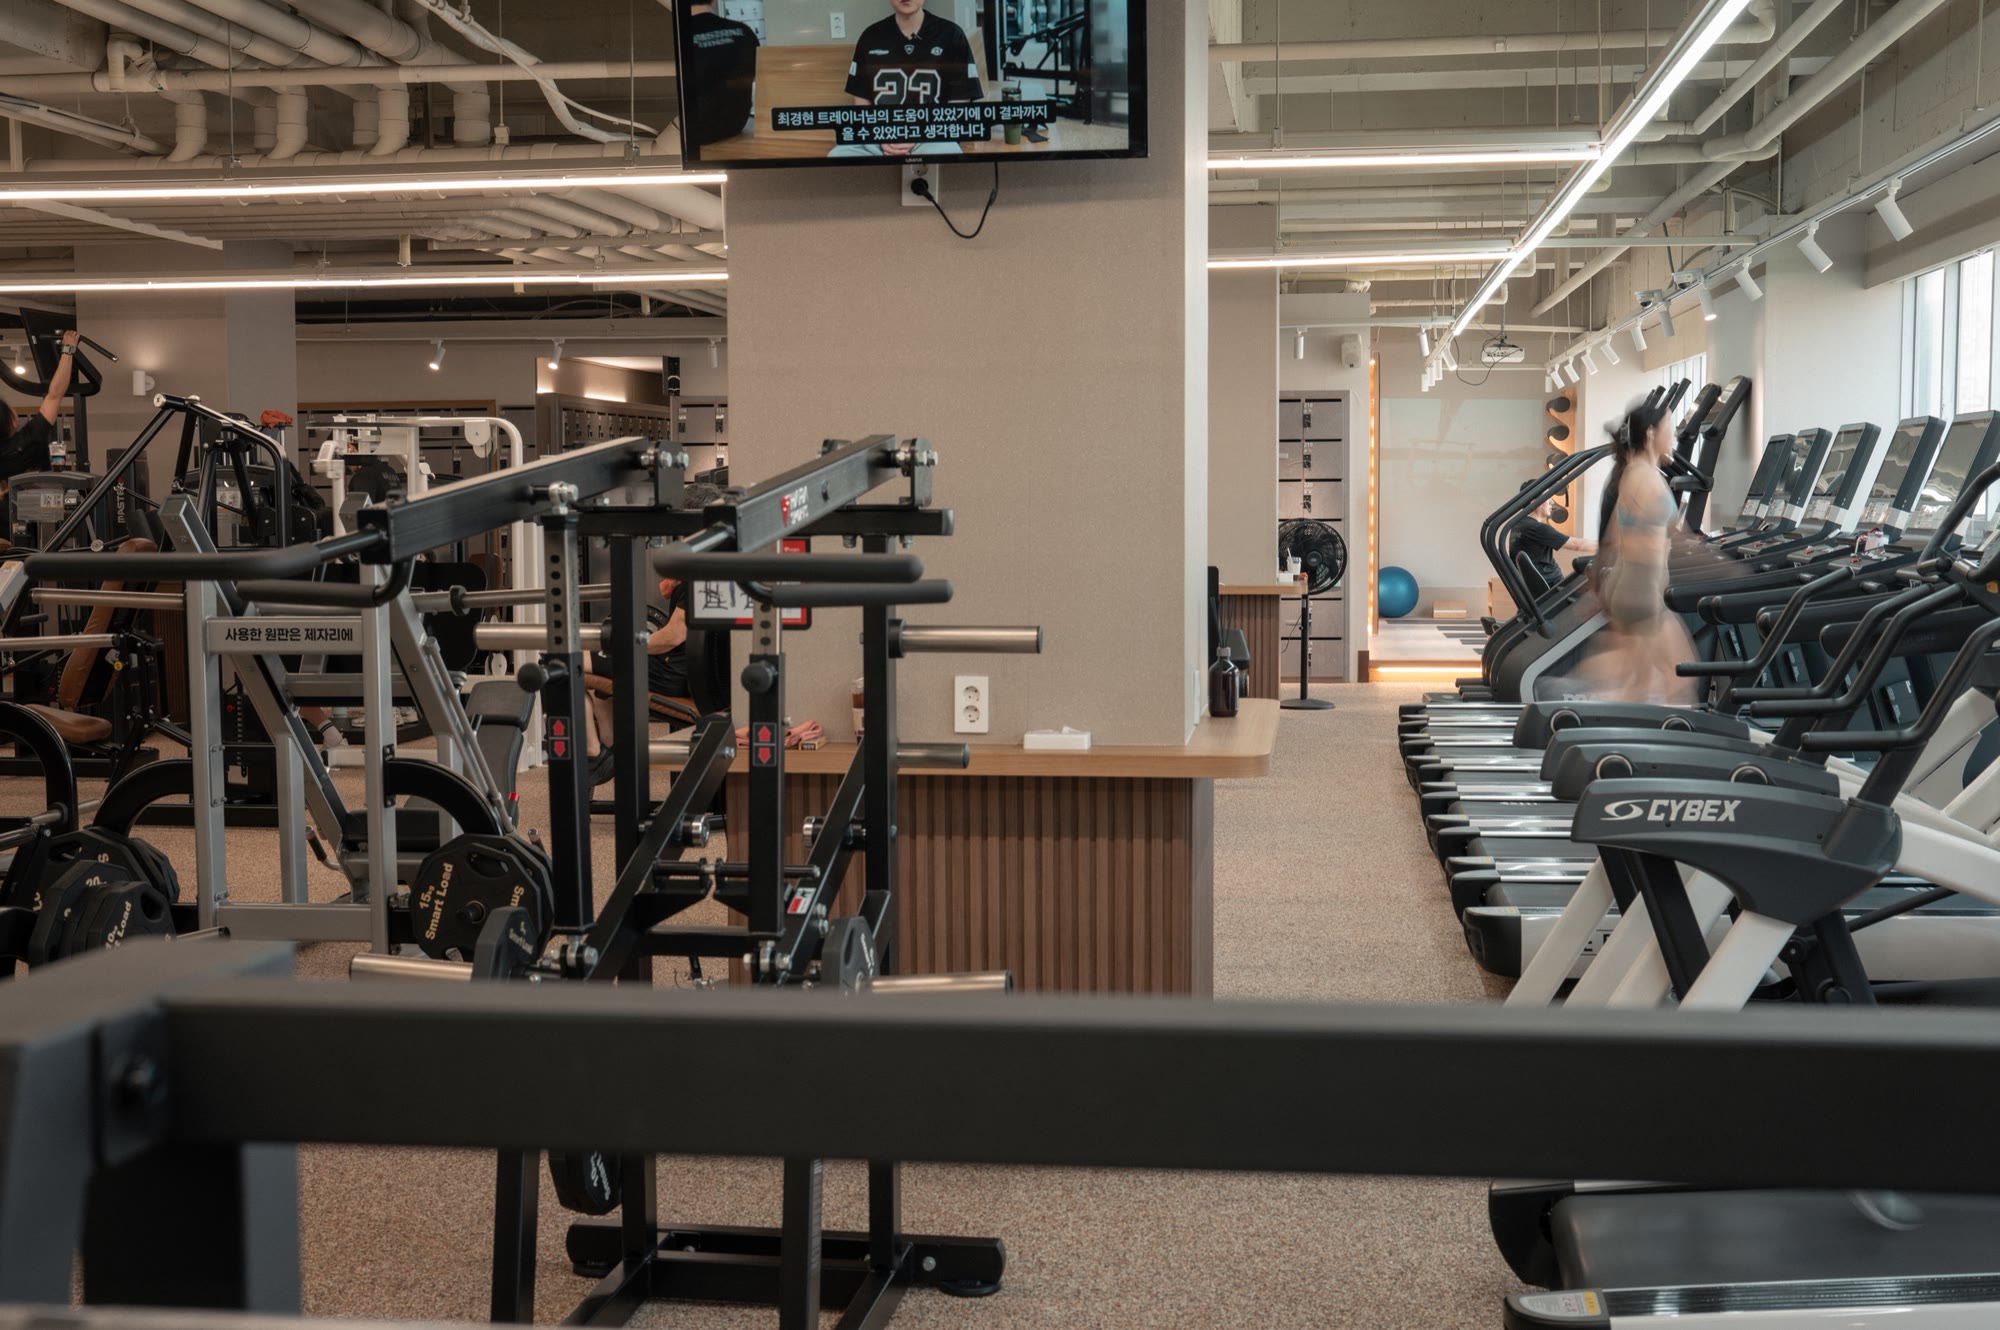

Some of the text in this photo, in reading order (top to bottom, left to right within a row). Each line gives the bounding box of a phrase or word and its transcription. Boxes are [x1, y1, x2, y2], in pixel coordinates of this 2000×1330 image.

[777, 105, 1048, 126] 최경현 트레이너님의 도움이 있었기에 이 결과까지
[857, 126, 870, 141] 수
[873, 125, 921, 140] 있었다고
[924, 123, 985, 139] 생각합니다
[225, 627, 353, 642] 사용한 원판은 제자리에
[1647, 799, 1741, 822] CYBEX
[425, 862, 454, 940] Smart Load
[117, 901, 132, 938] Load
